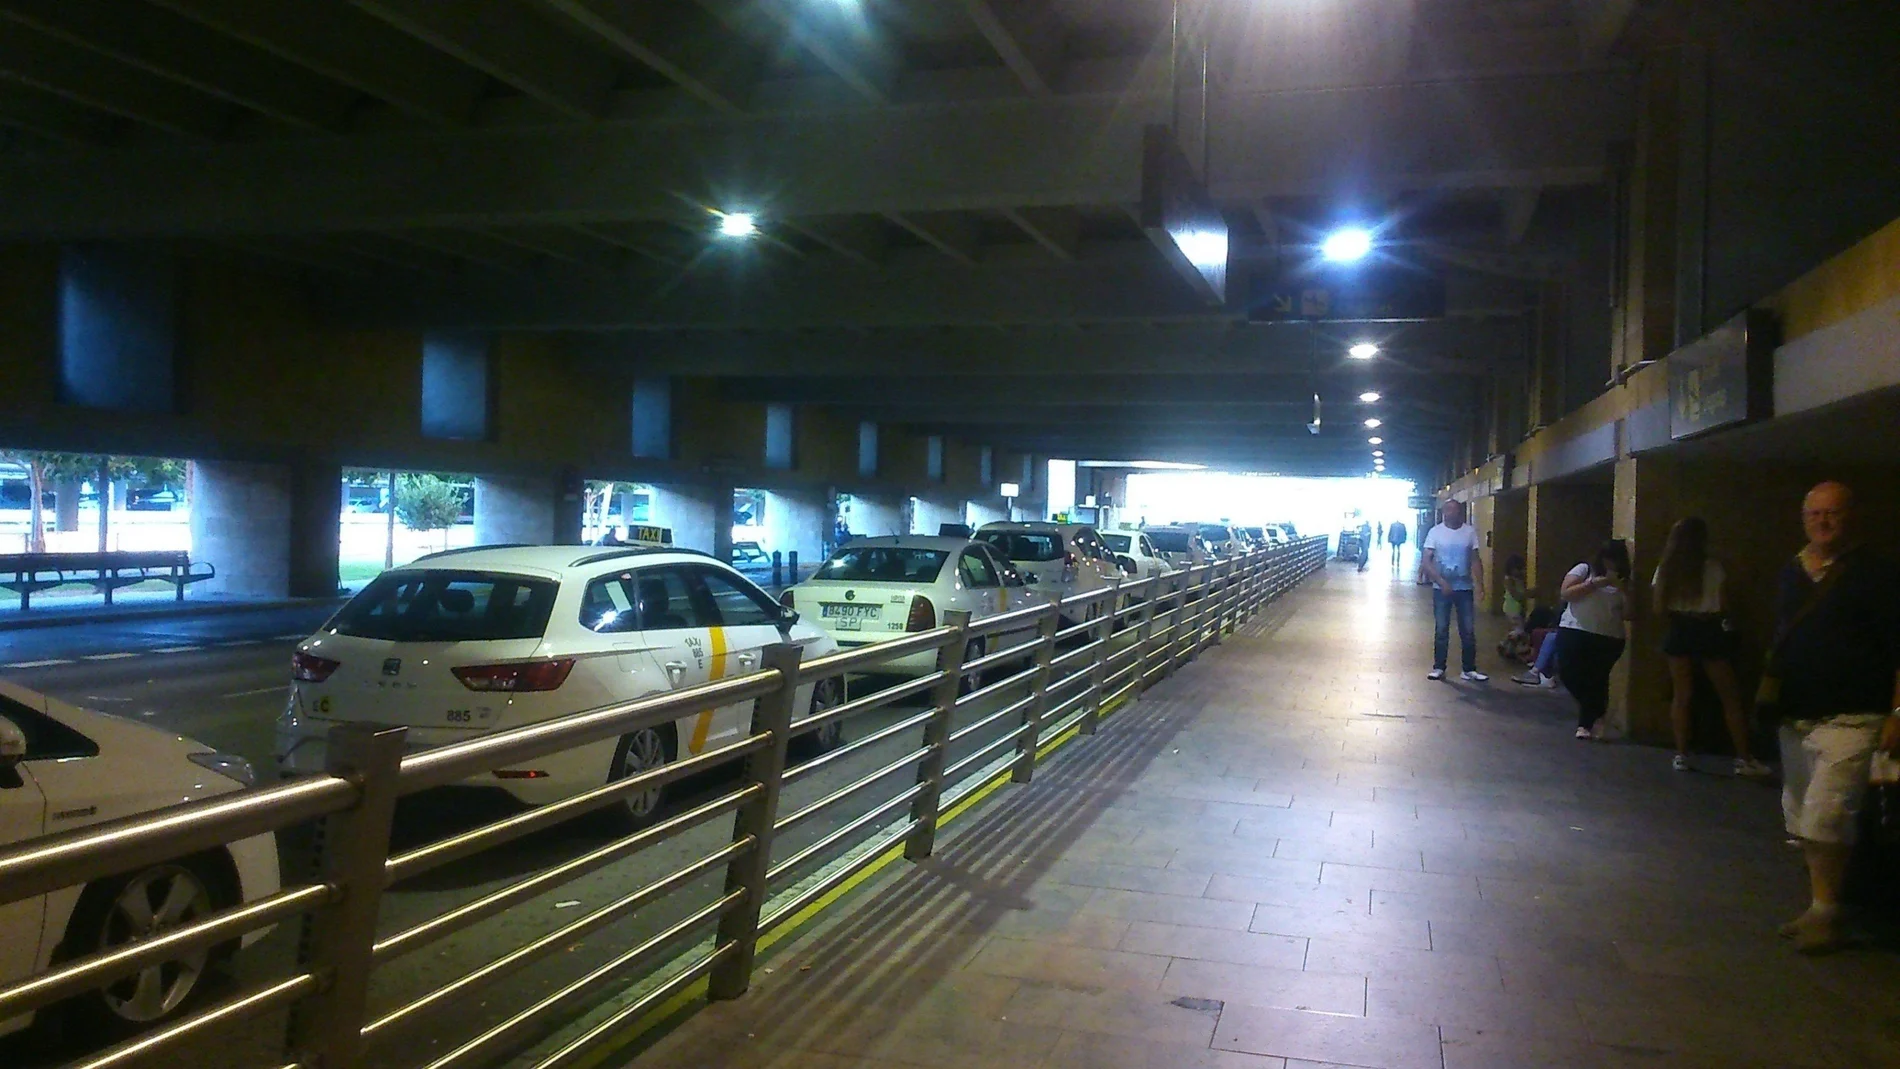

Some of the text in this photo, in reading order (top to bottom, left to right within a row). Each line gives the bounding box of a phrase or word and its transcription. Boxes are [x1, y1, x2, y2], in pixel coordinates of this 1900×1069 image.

[638, 526, 660, 541] TAXI
[829, 605, 877, 618] 8490 FYC
[841, 617, 857, 628] SP
[447, 709, 471, 722] 885
